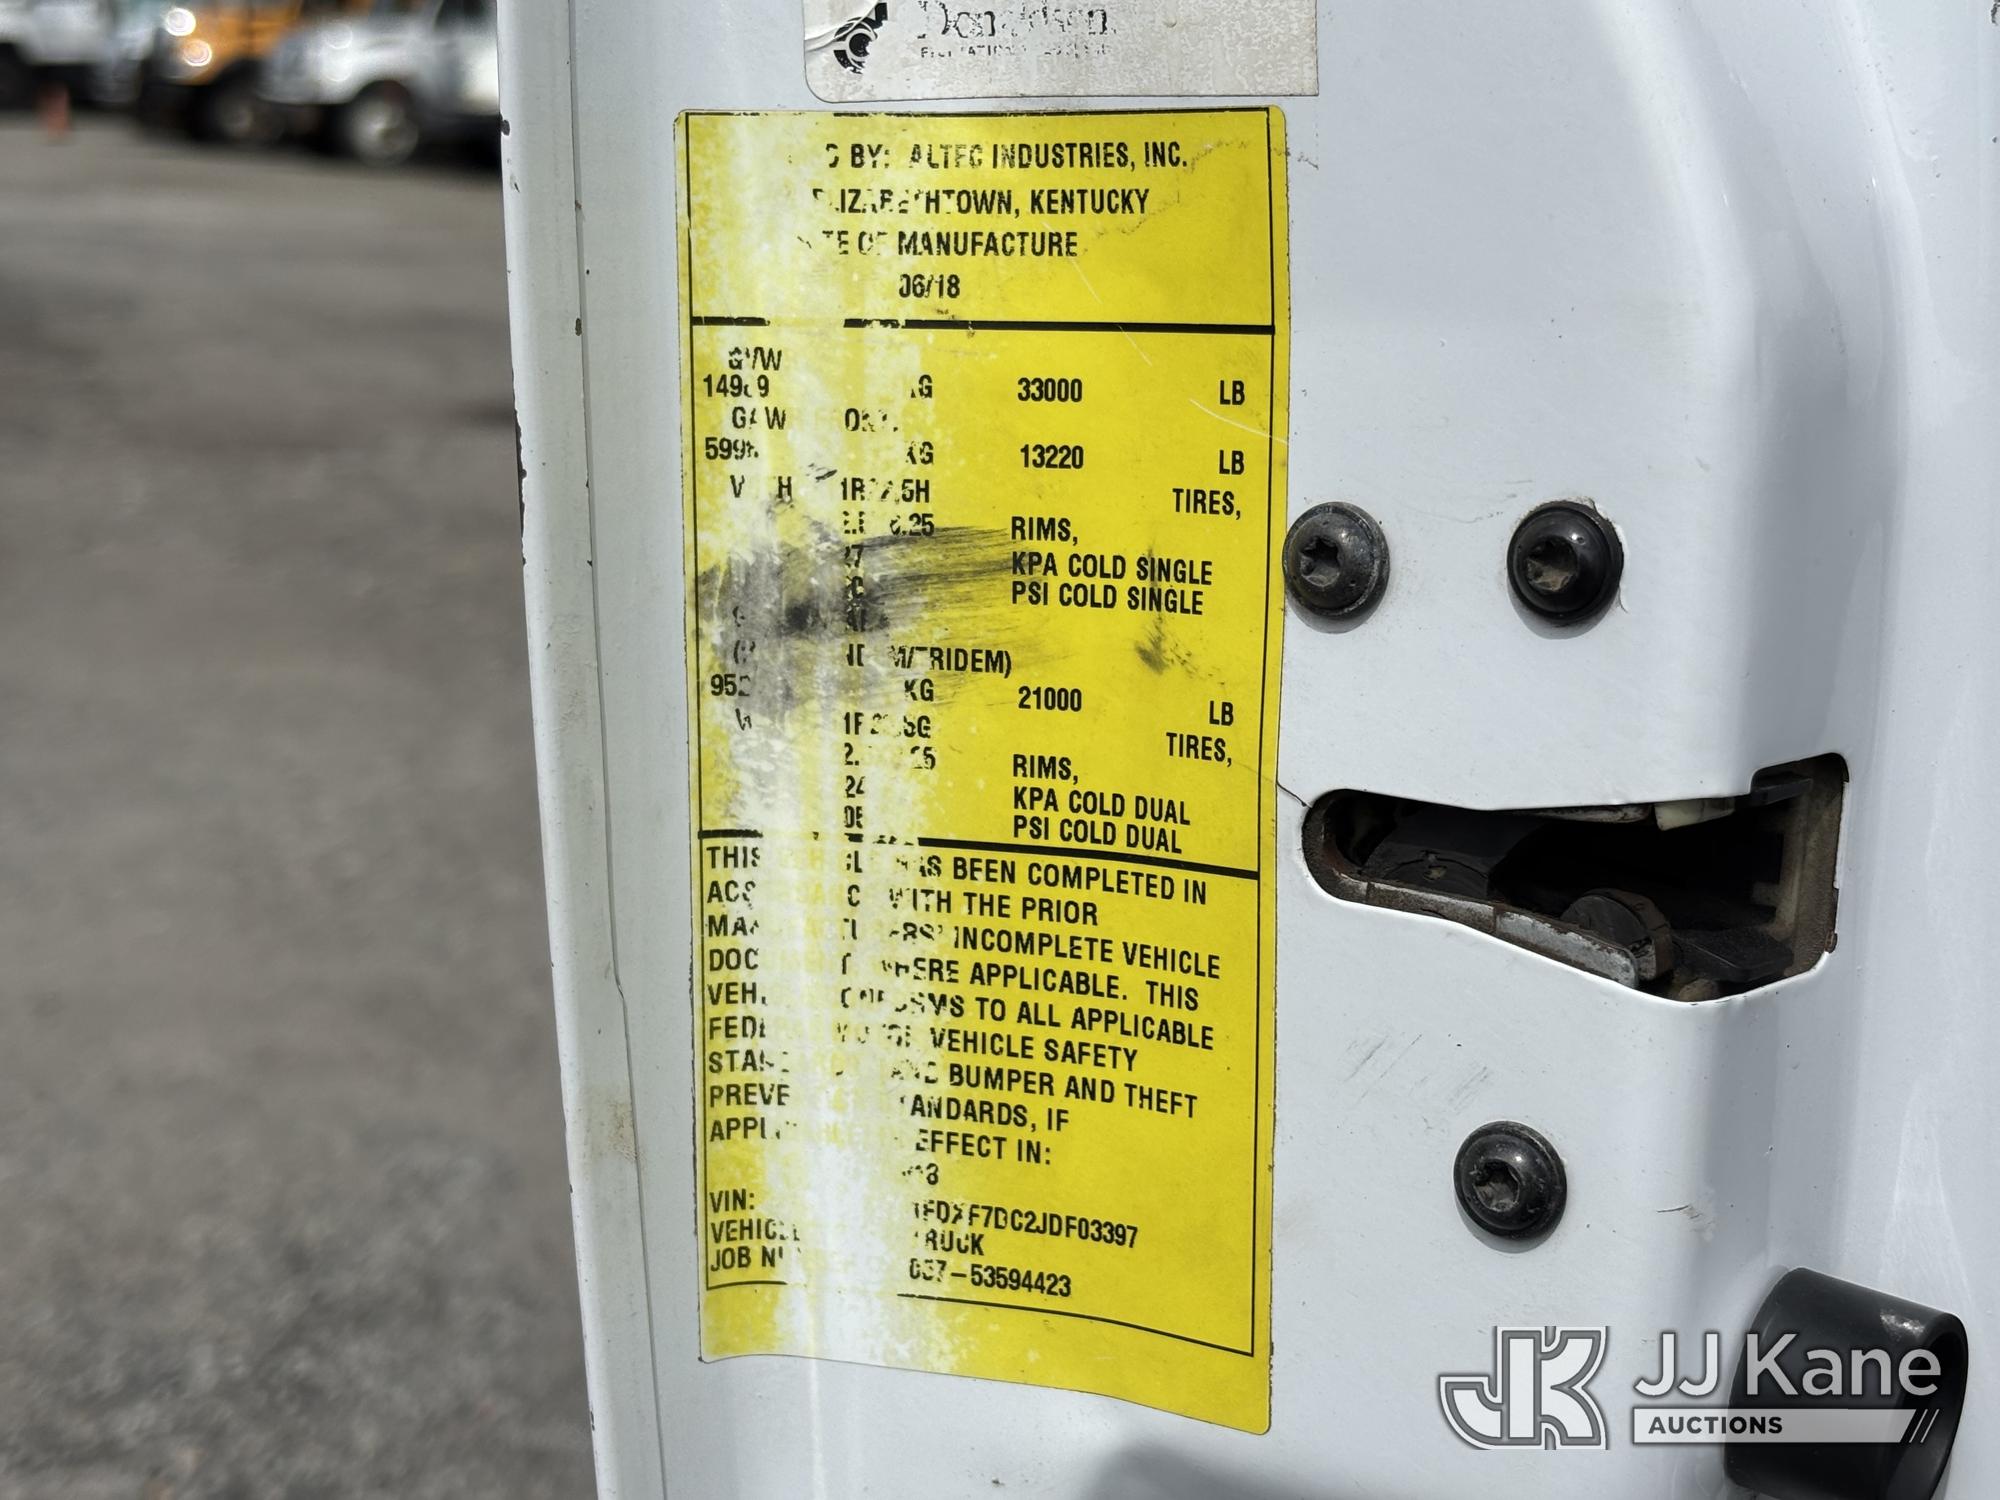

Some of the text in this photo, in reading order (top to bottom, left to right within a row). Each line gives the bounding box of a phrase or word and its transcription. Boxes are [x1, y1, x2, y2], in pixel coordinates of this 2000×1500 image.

[850, 143, 890, 169] BY:
[992, 142, 1136, 172] INDUSTRIES,
[1144, 141, 1188, 167] INC.
[1030, 188, 1150, 215] KENTUCKY
[898, 231, 1078, 257] MANUFACTURE
[1017, 377, 1083, 402] 33000
[1219, 379, 1246, 406] LB
[1020, 444, 1084, 470] 13220
[1218, 449, 1245, 476] LB
[1172, 488, 1241, 520] TIRES,
[1011, 516, 1079, 546] RIMS,
[1012, 551, 1213, 586] KPA COLD SINGLE
[1012, 580, 1204, 616] PSI COLD SINGLE
[904, 678, 935, 702] KG
[1018, 686, 1083, 712] 21000
[1209, 700, 1235, 727] LB
[1166, 732, 1232, 768] TIRES,
[1013, 754, 1079, 785] RIMS,
[1013, 786, 1059, 813] KPA
[1069, 790, 1126, 818] COLD
[1135, 796, 1191, 826] DUAL
[1013, 815, 1049, 841] PSI
[1059, 818, 1117, 846] COLD
[1126, 823, 1183, 854] DUAL
[953, 856, 1016, 884] BEEN
[1028, 862, 1175, 900] COMPLETED
[1184, 878, 1207, 905] IN
[963, 892, 1011, 918] THE
[1022, 896, 1098, 926] PRIOR
[954, 925, 1114, 963] INCOMPLETE
[1122, 940, 1220, 979] VEHICLE
[970, 961, 1128, 1000] APPLICABLE.
[1146, 980, 1199, 1011] THIS
[975, 996, 1007, 1022] TO
[1017, 1001, 1061, 1028] ALL
[1071, 1006, 1215, 1050] APPLICABLE
[929, 1026, 1034, 1059] VEHICLE
[1044, 1038, 1138, 1072] SAFETY
[949, 1062, 1055, 1097] BUMPER
[1064, 1075, 1115, 1103] AND
[1124, 1083, 1198, 1119] THEFT
[1047, 1107, 1070, 1132] IF
[916, 1128, 1051, 1165] EFFECT IN:
[709, 1187, 755, 1214] VIN:
[711, 1246, 752, 1273] JOB
